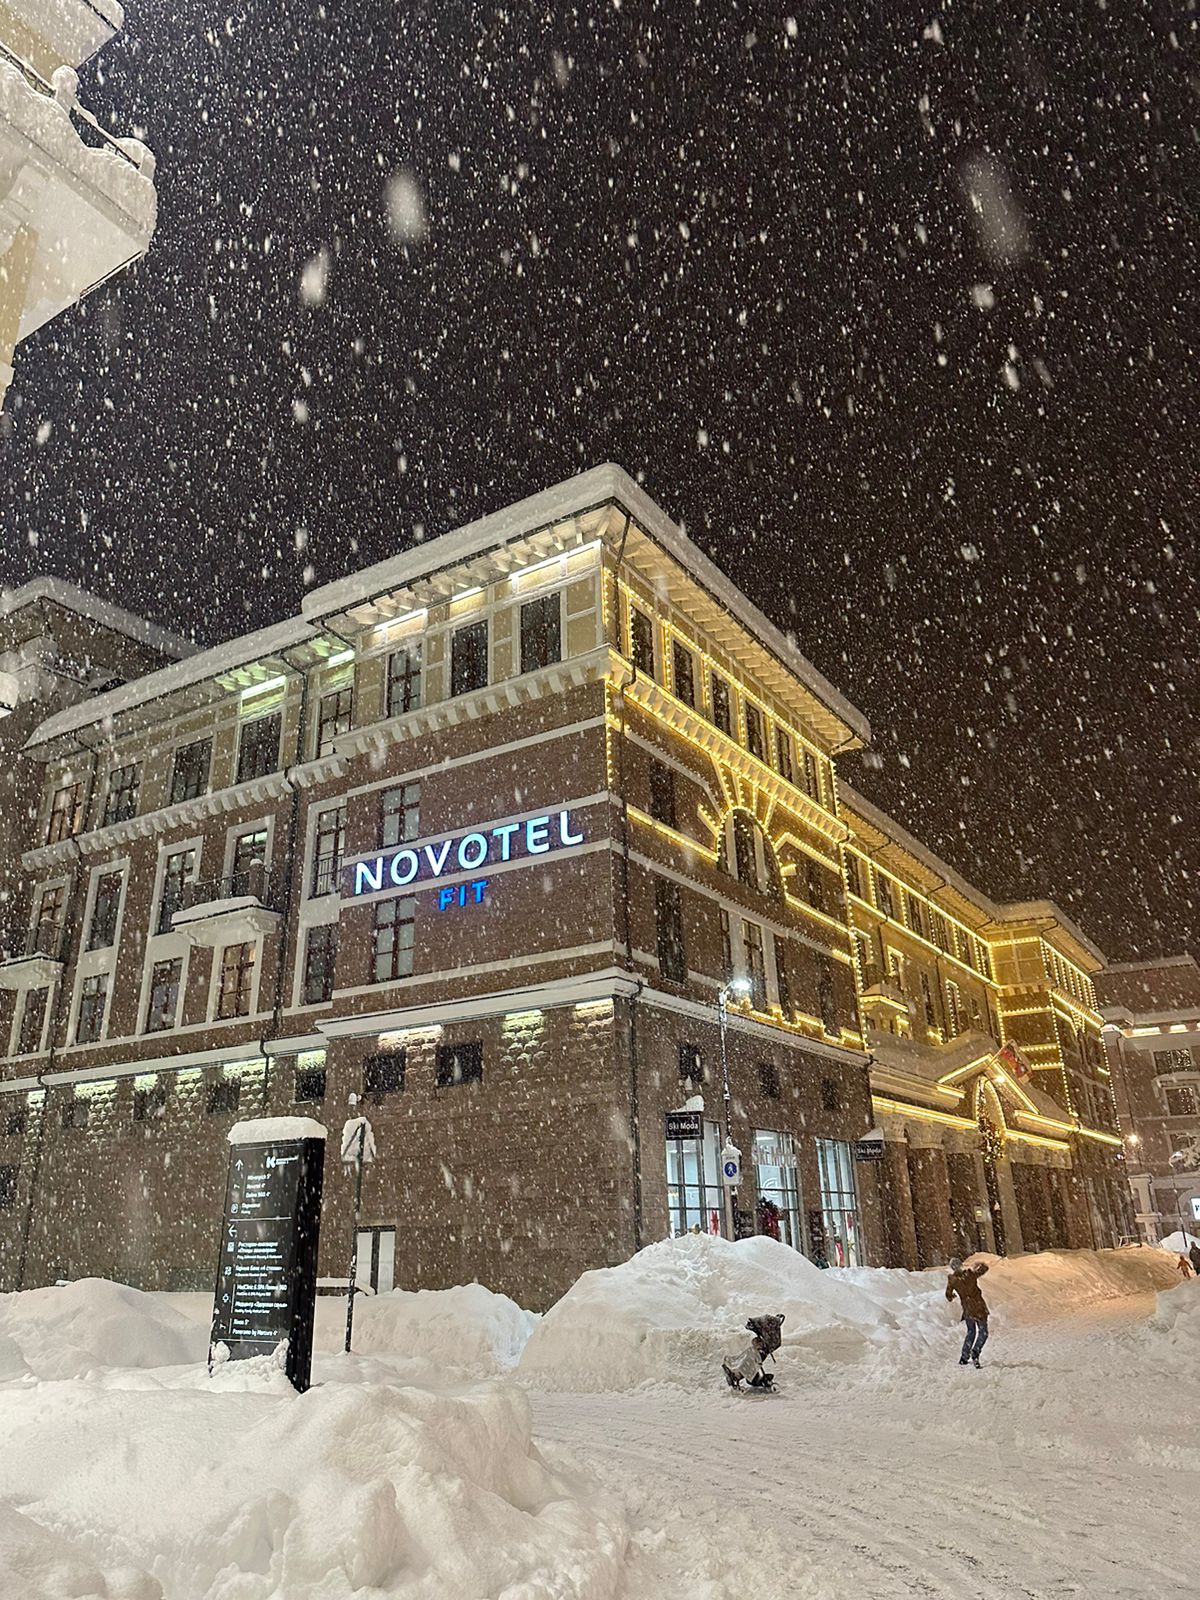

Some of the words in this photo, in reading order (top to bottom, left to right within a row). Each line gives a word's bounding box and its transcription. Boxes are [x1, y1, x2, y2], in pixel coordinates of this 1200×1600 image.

[354, 810, 584, 895] NOVOTEL
[438, 879, 488, 911] FIT
[668, 1122, 680, 1130] Ski
[680, 1120, 699, 1130] Moda
